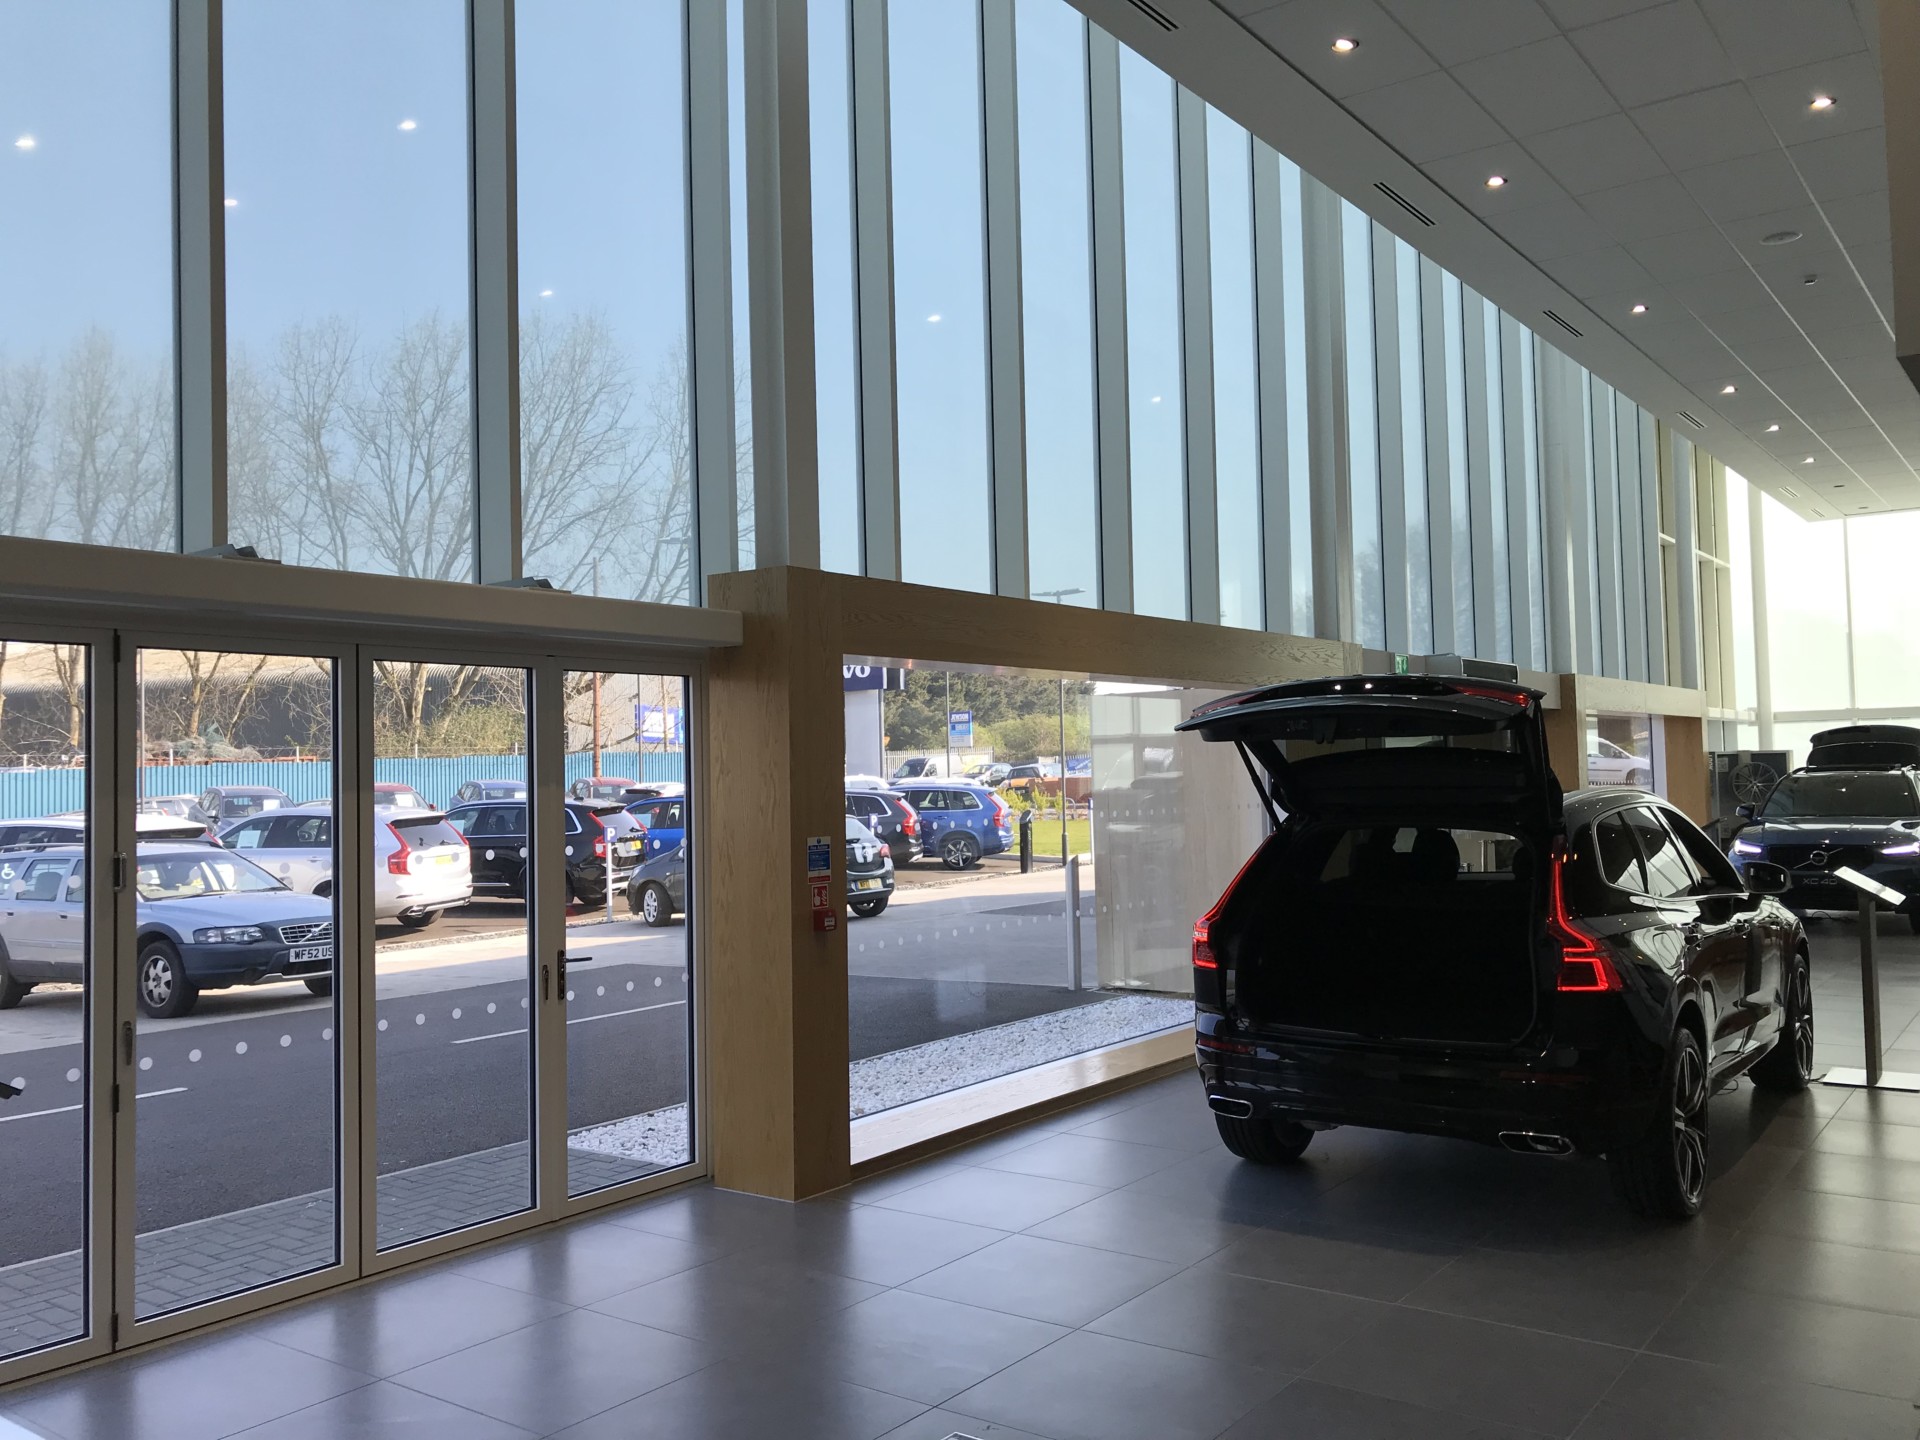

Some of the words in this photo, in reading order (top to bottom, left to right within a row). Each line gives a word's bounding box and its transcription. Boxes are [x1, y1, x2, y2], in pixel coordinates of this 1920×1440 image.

[871, 815, 878, 826] P
[607, 827, 616, 841] P
[294, 948, 320, 960] WF52
